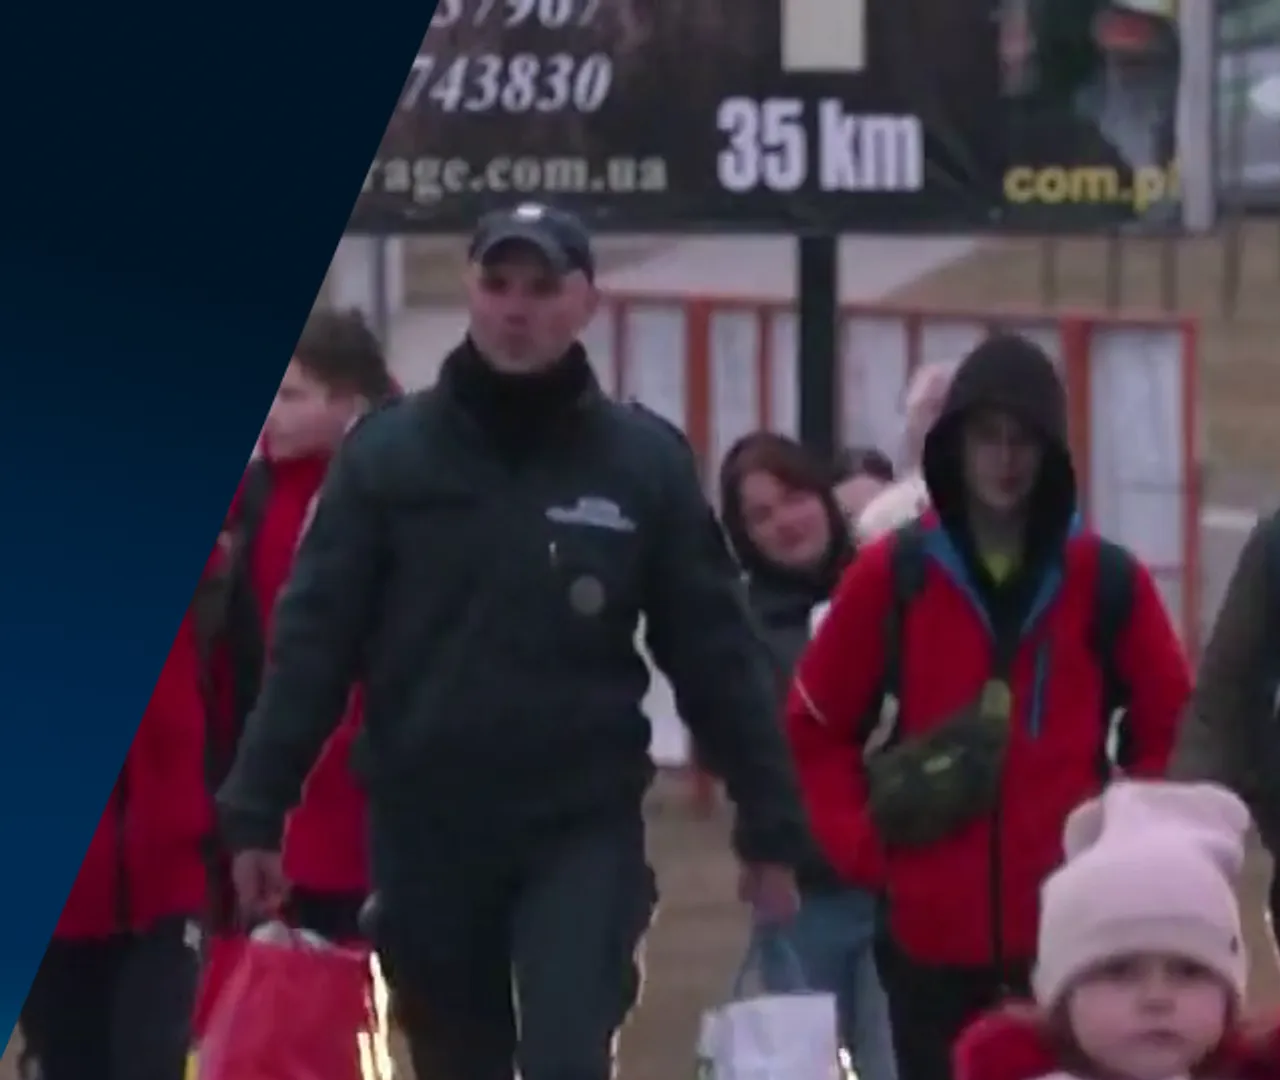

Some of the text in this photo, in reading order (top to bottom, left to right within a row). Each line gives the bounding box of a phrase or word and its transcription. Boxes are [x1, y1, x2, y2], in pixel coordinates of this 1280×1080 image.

[401, 52, 612, 112] 743830
[716, 95, 924, 193] 35 km
